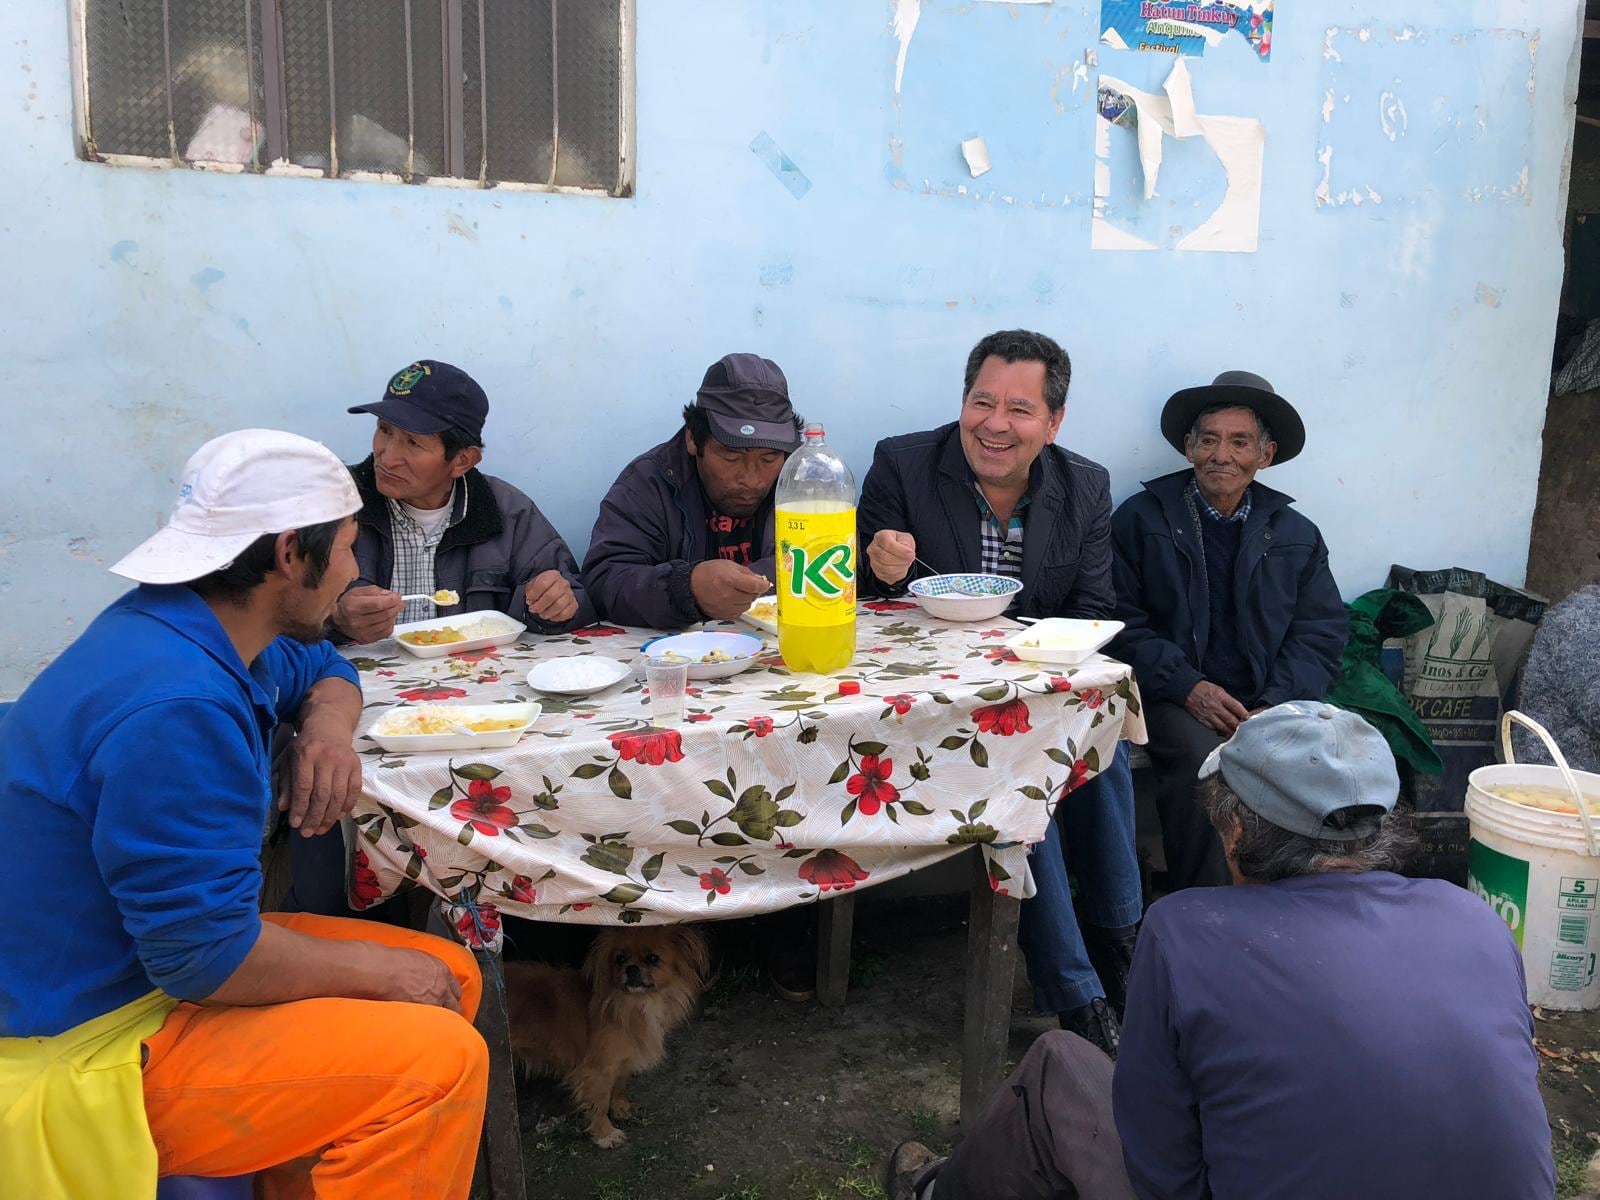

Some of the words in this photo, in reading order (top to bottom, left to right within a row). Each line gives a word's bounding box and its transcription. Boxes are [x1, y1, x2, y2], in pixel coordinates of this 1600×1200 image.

[1140, 2, 1185, 19] Hatun
[1187, 5, 1239, 27] Tinkuy
[1139, 42, 1180, 54] Festival
[1430, 699, 1472, 717] CAFE
[1574, 880, 1585, 893] 5
